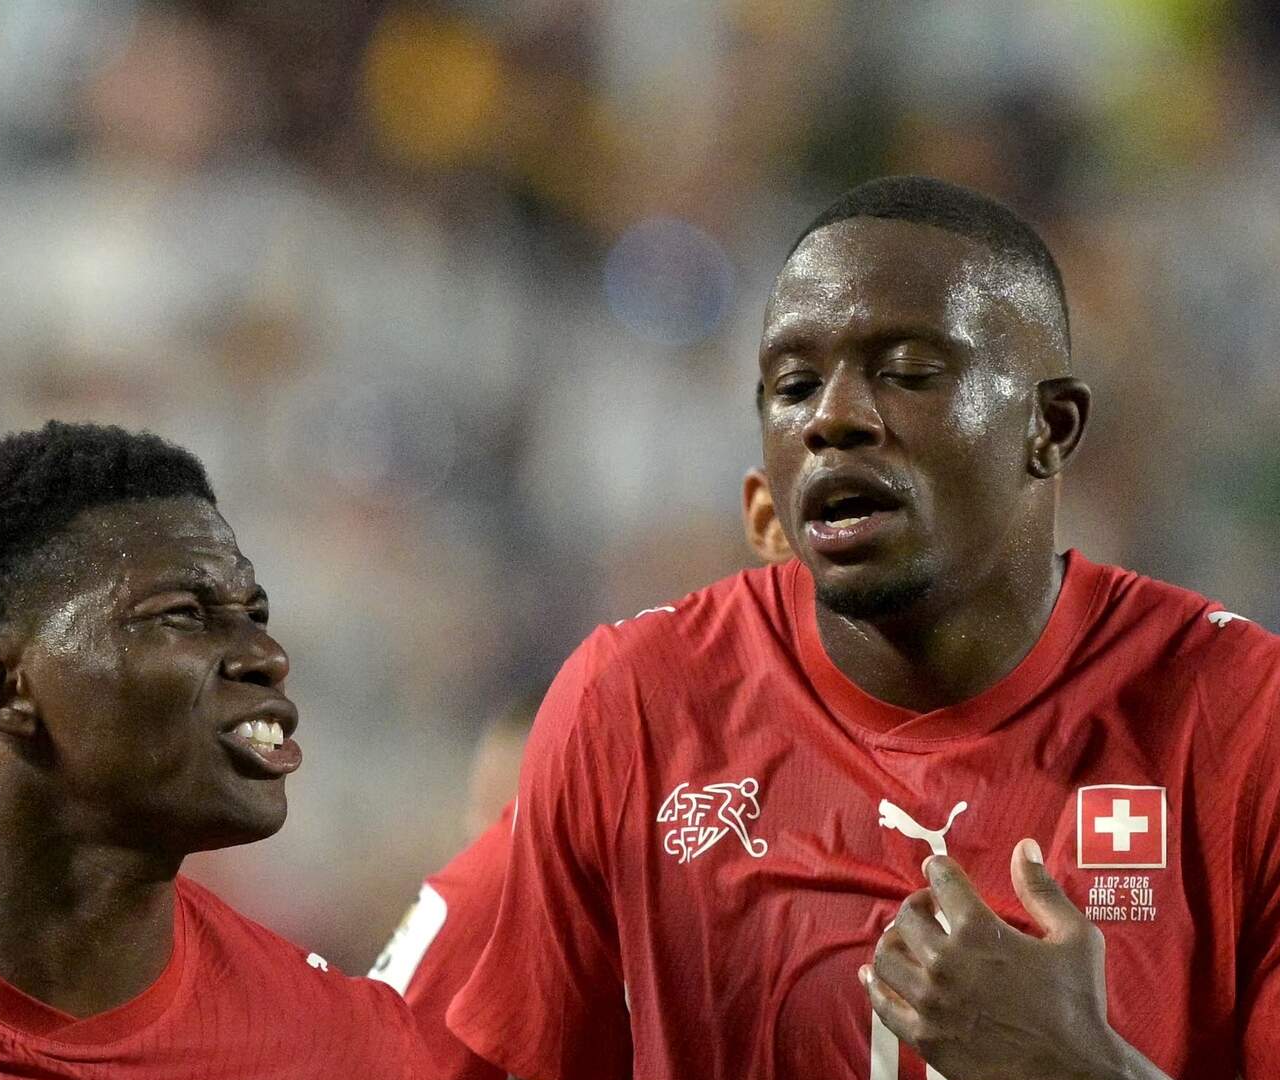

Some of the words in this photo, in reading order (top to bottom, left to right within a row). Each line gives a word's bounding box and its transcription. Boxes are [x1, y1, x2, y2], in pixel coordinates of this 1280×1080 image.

[1093, 876, 1150, 889] 11.07.2026
[1088, 888, 1116, 906] ARG
[1130, 888, 1153, 906] SUI
[1085, 906, 1128, 921] KANSAS
[1130, 906, 1157, 921] CITY
